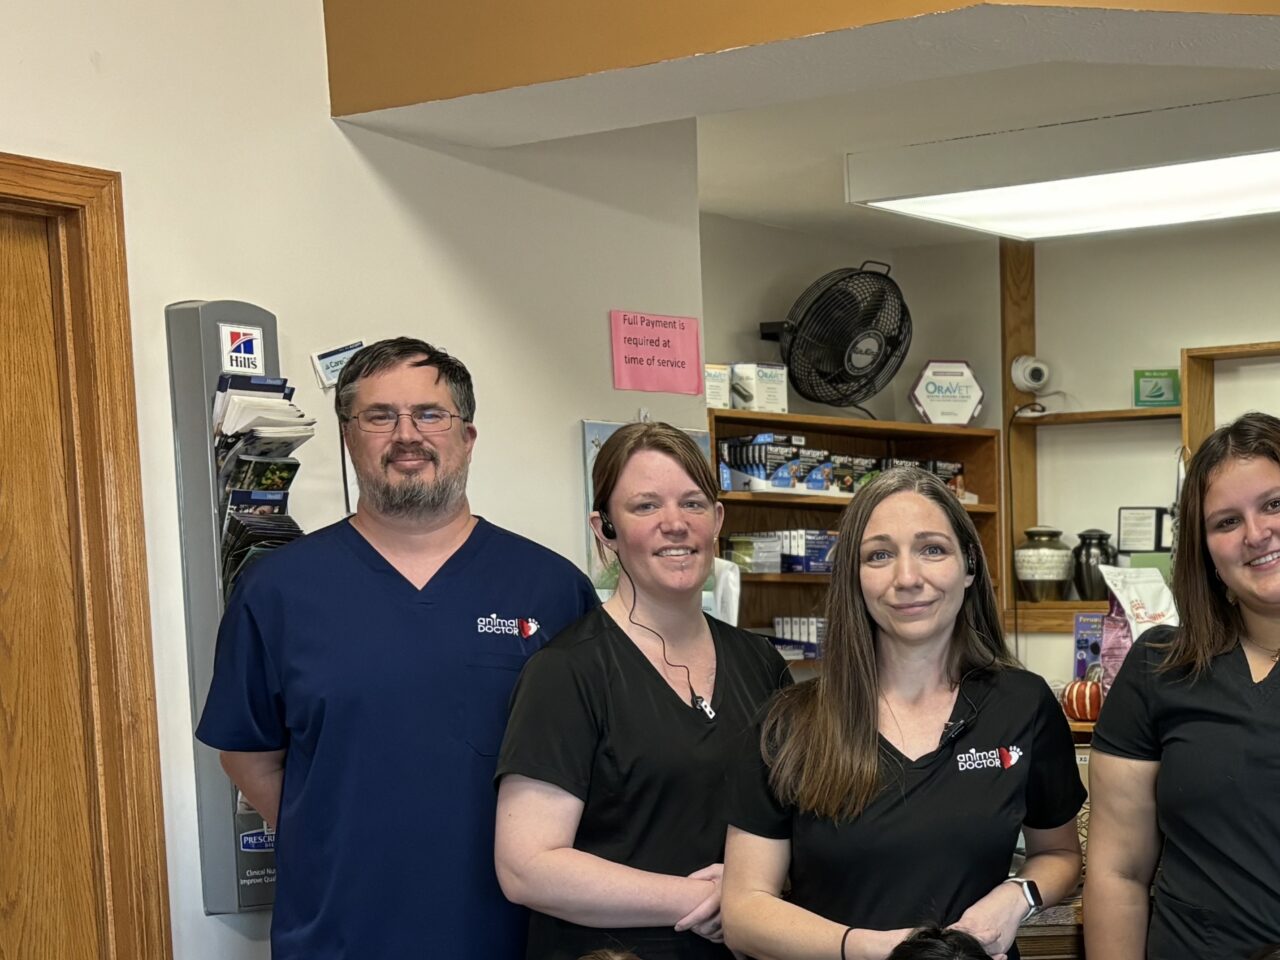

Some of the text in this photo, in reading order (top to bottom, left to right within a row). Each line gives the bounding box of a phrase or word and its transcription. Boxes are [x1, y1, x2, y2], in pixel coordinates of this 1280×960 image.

[623, 314, 685, 330] Full Payment is
[623, 336, 671, 348] required at
[230, 355, 258, 370] Hill's
[624, 355, 686, 369] time of service
[477, 613, 518, 627] animal
[477, 625, 519, 636] DOCTOR
[957, 748, 999, 762] animal
[958, 758, 1001, 771] DOCTOR
[243, 835, 275, 844] PRESCRI
